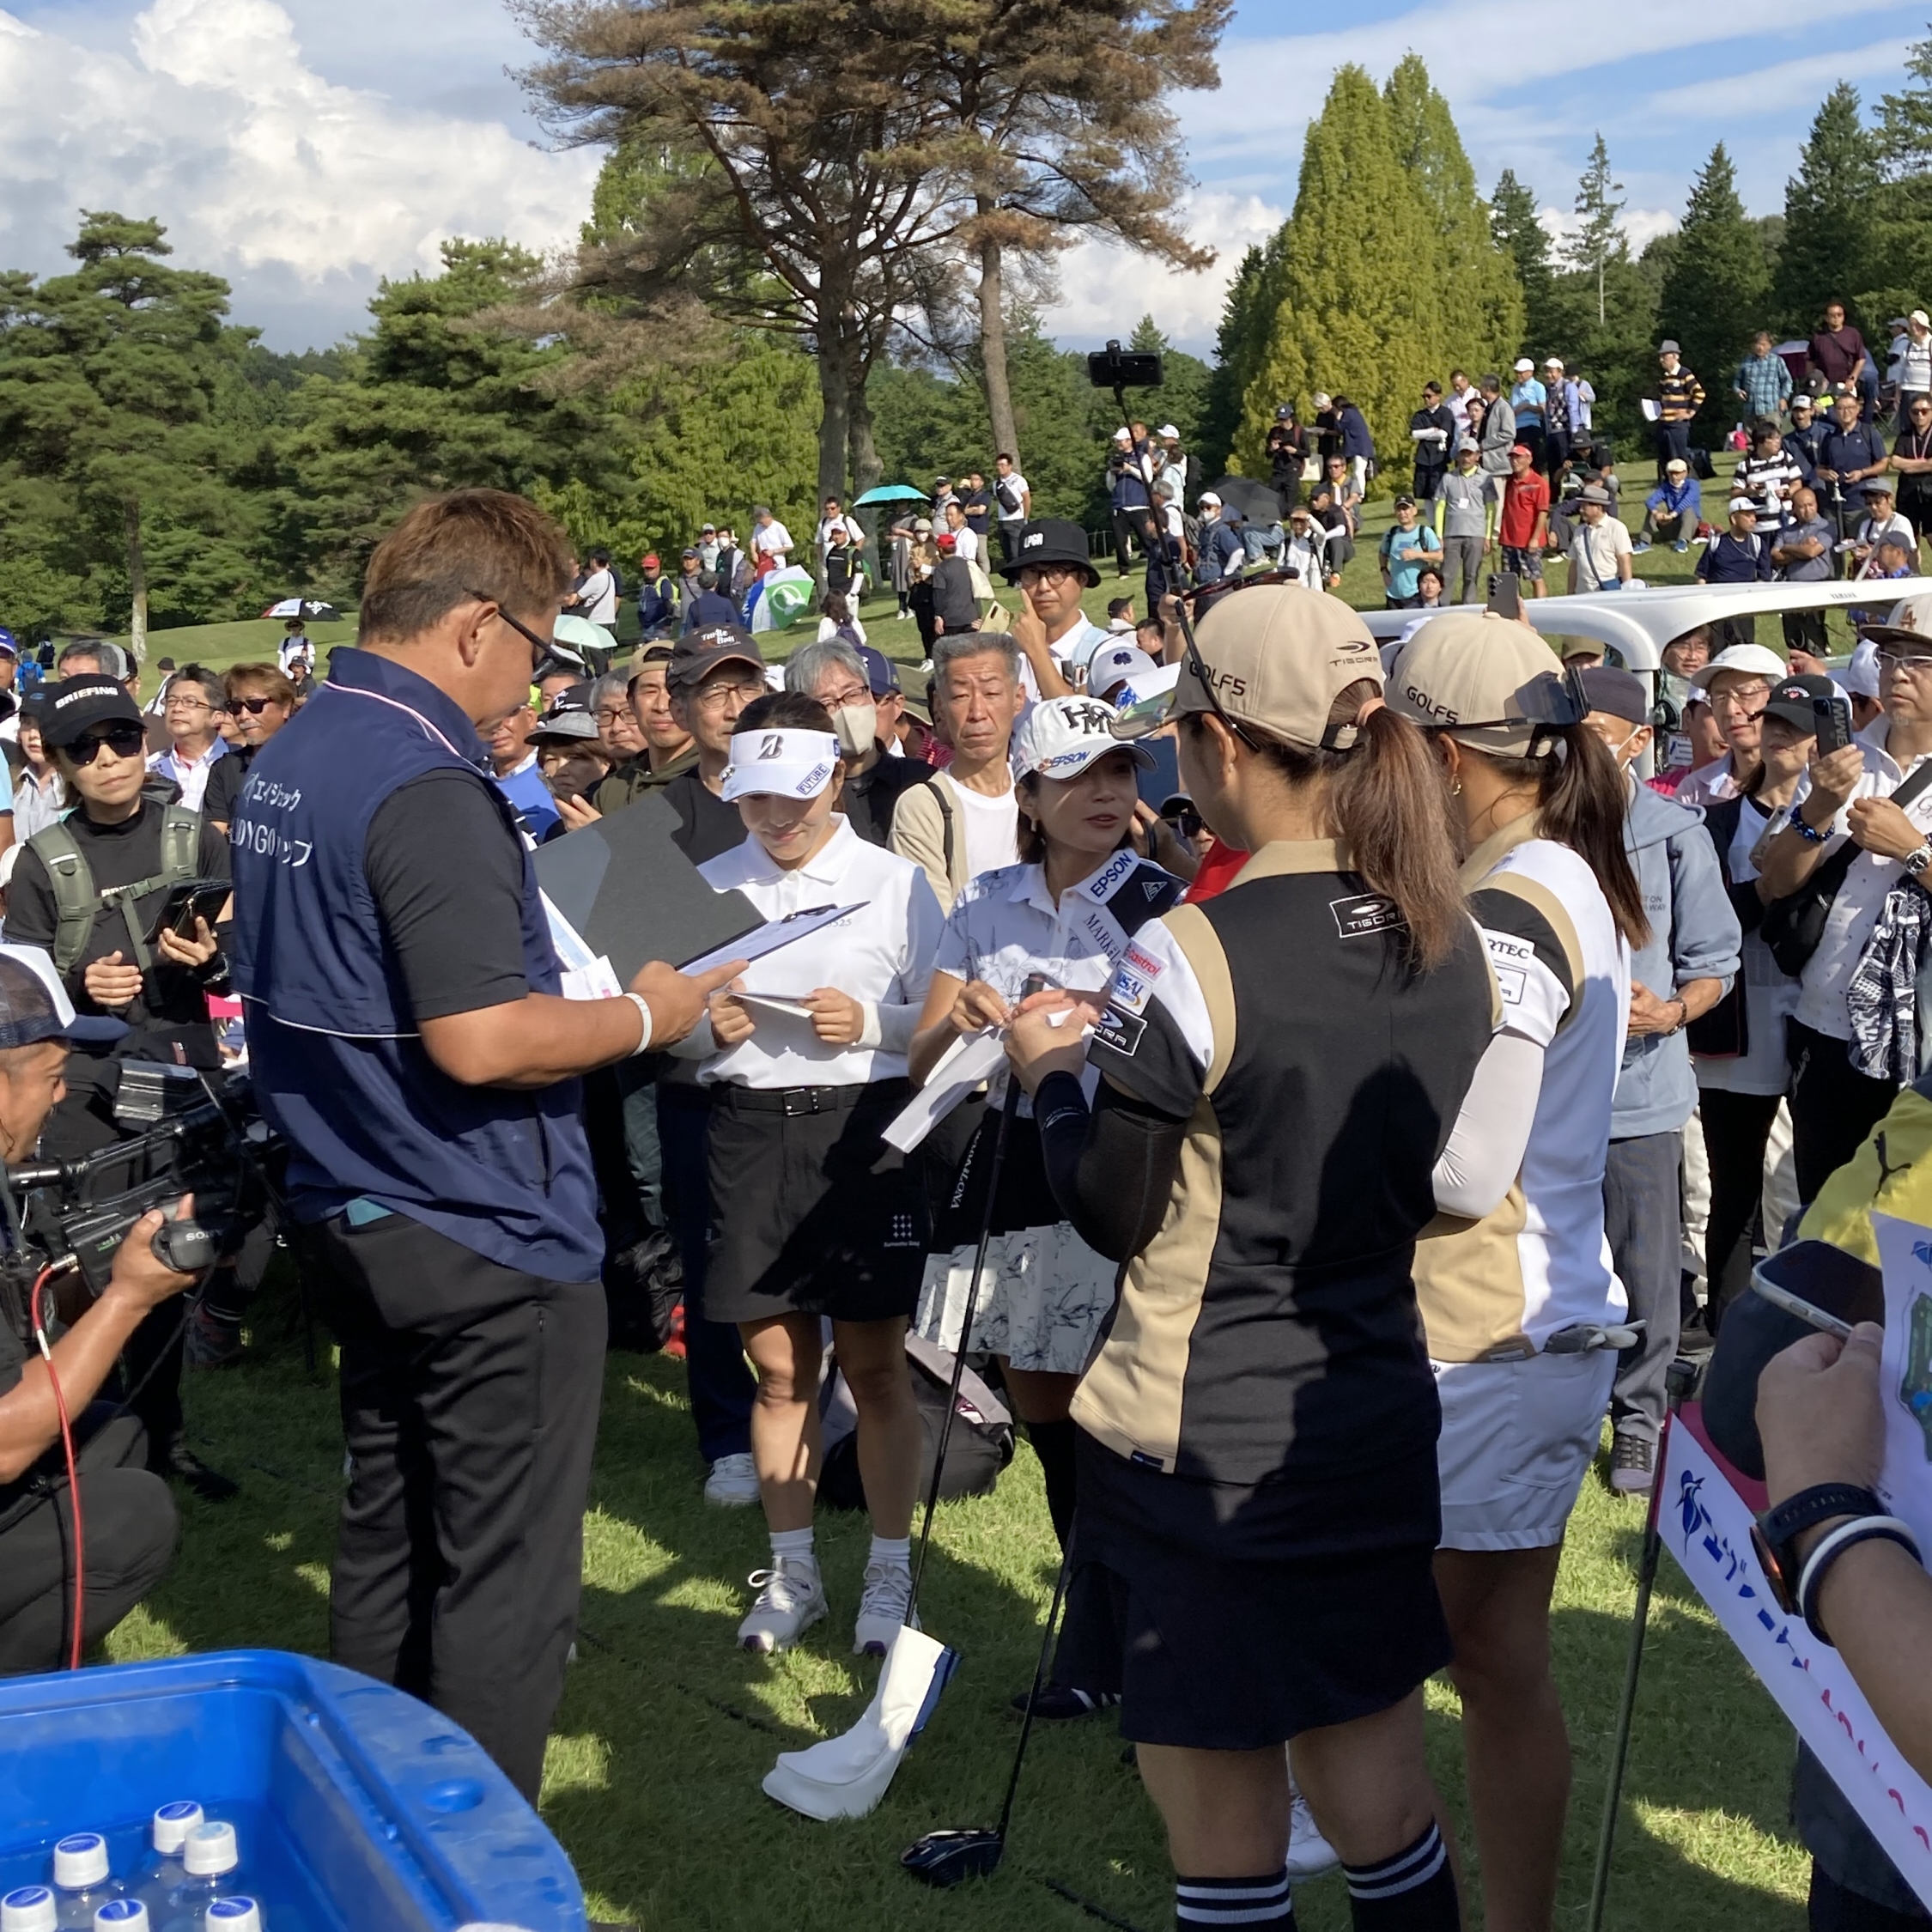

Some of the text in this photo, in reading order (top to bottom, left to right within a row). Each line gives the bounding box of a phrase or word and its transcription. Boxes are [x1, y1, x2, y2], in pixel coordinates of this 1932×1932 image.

[55, 686, 118, 709] BRIEFING
[1051, 750, 1091, 769] EPSON
[799, 765, 828, 793] FUTURE
[1090, 852, 1133, 898] EPSON
[1346, 912, 1405, 930] TIGOR
